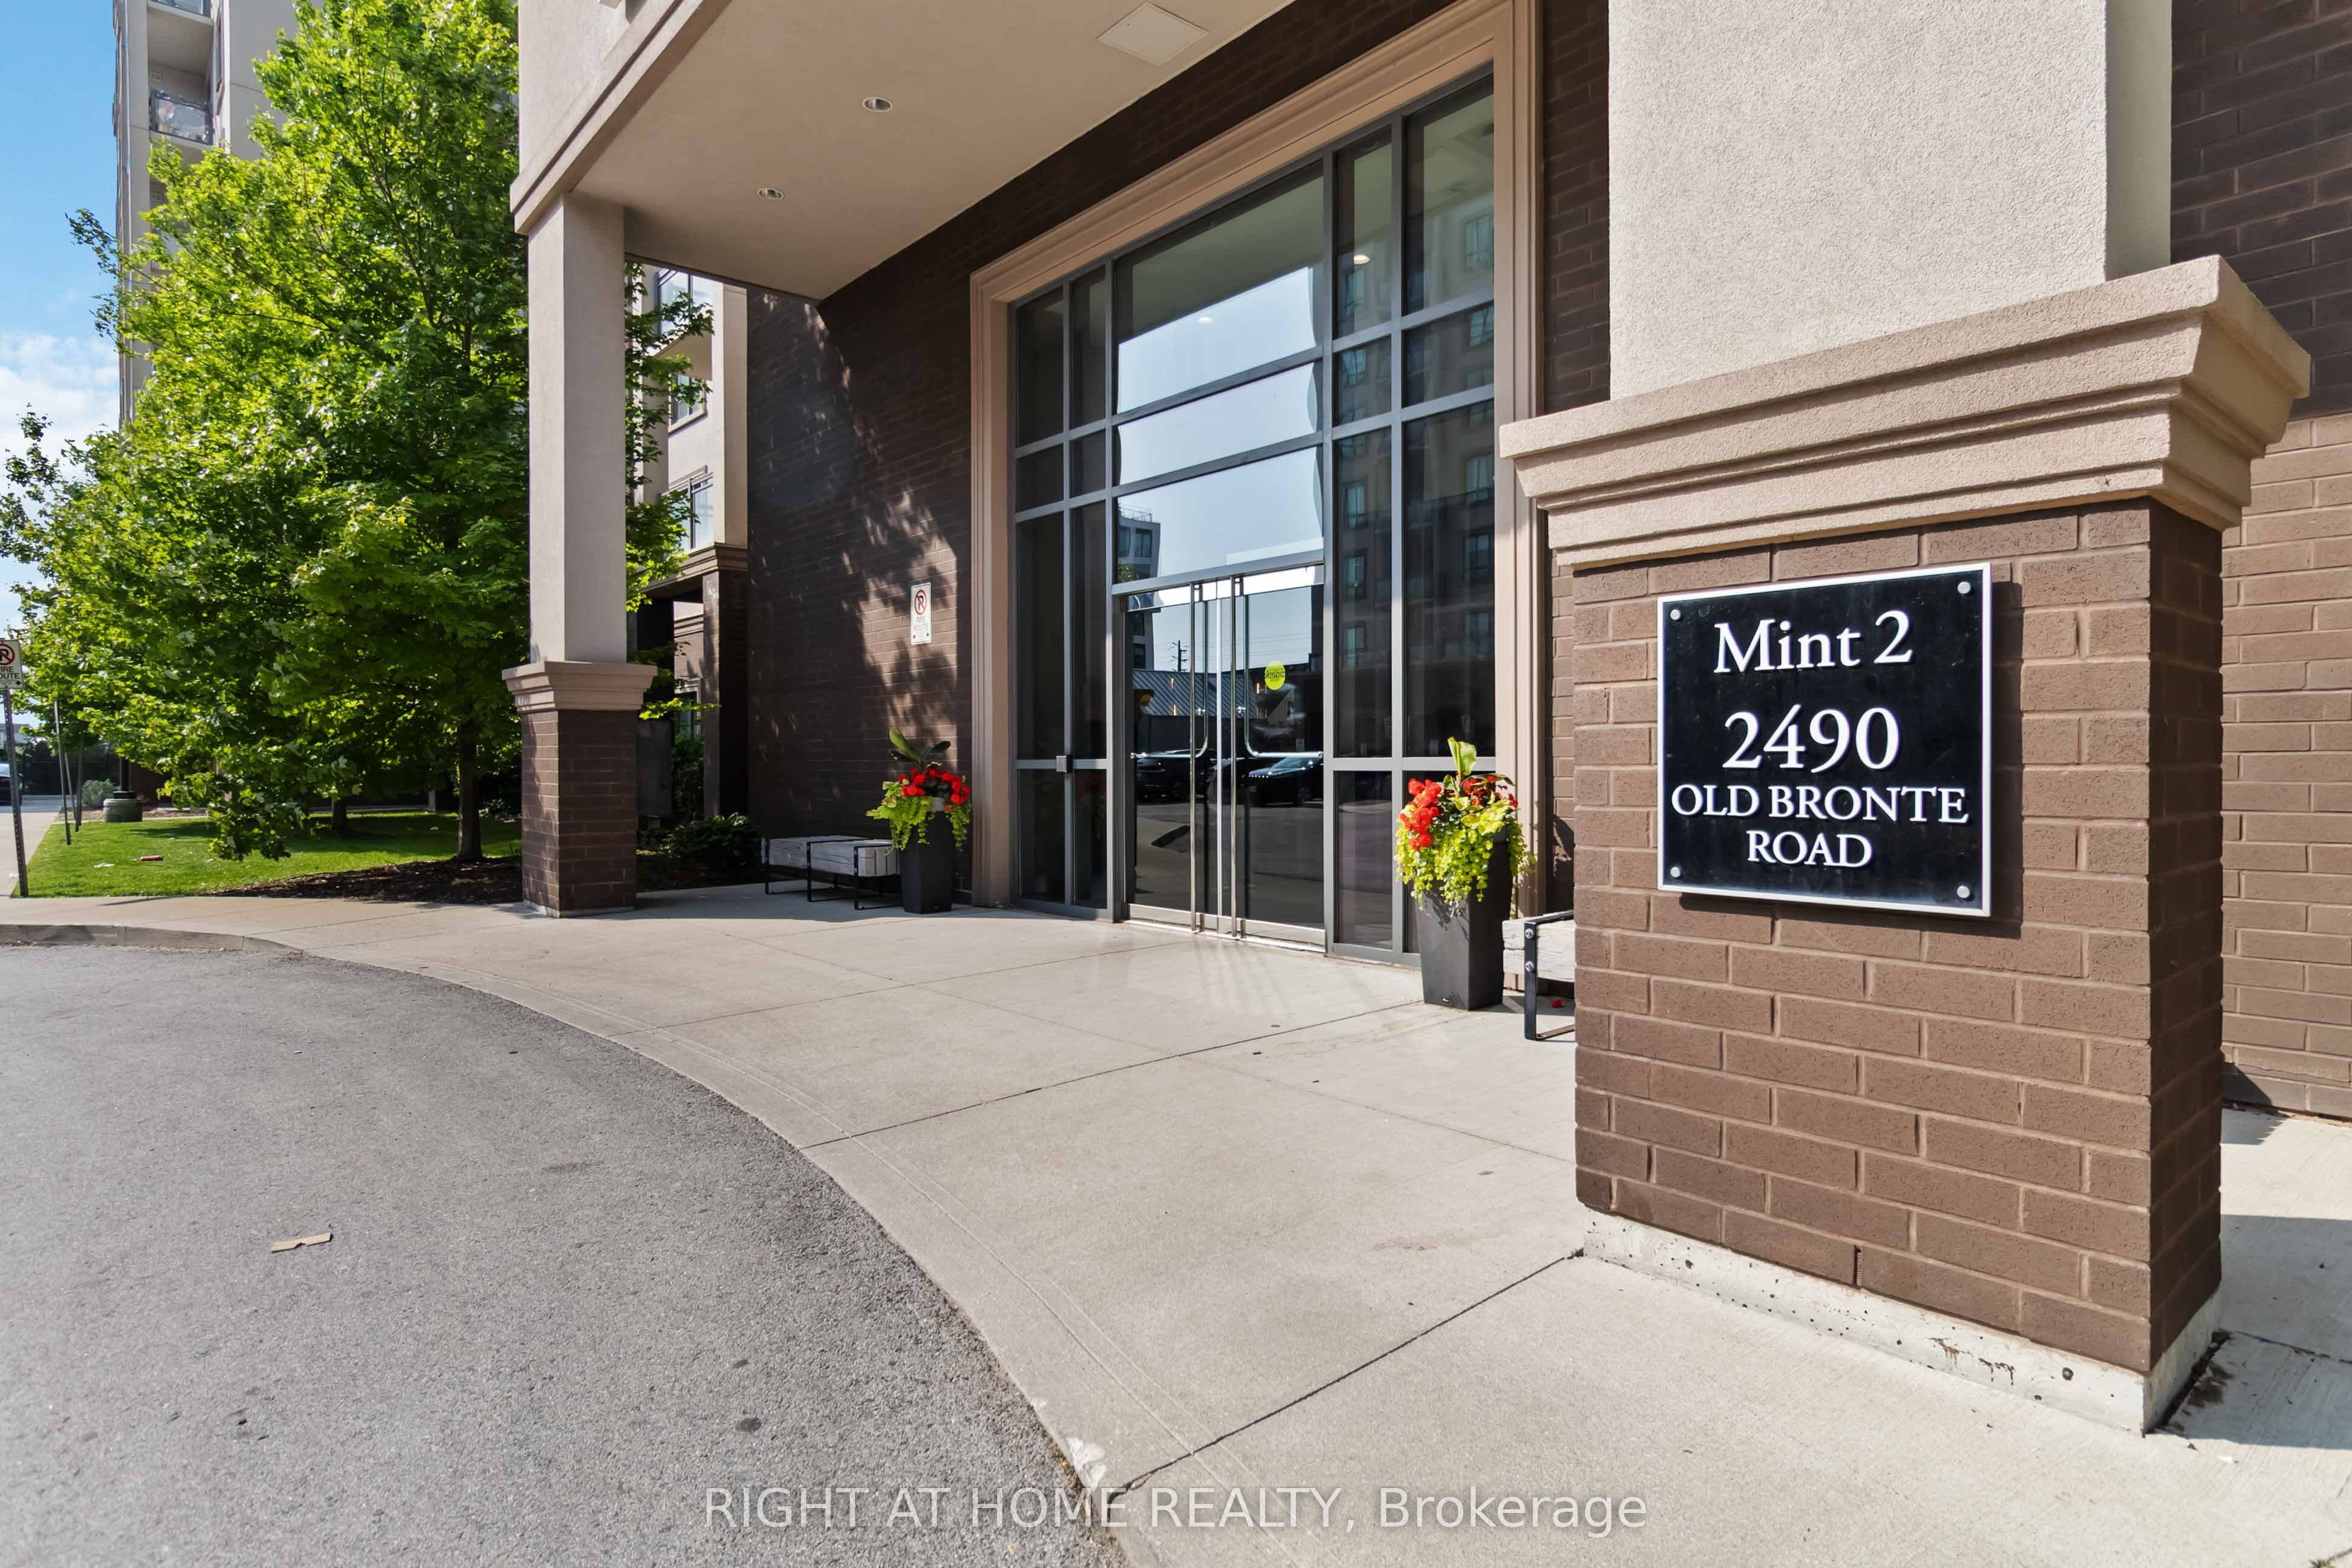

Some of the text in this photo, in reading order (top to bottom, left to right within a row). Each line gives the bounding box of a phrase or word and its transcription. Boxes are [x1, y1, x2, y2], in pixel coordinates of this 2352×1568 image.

[1713, 610, 1913, 673] Mint 2
[1722, 704, 1900, 774] 2490
[1671, 783, 1969, 824] OLD BRONTE
[1746, 829, 1873, 868] ROAD
